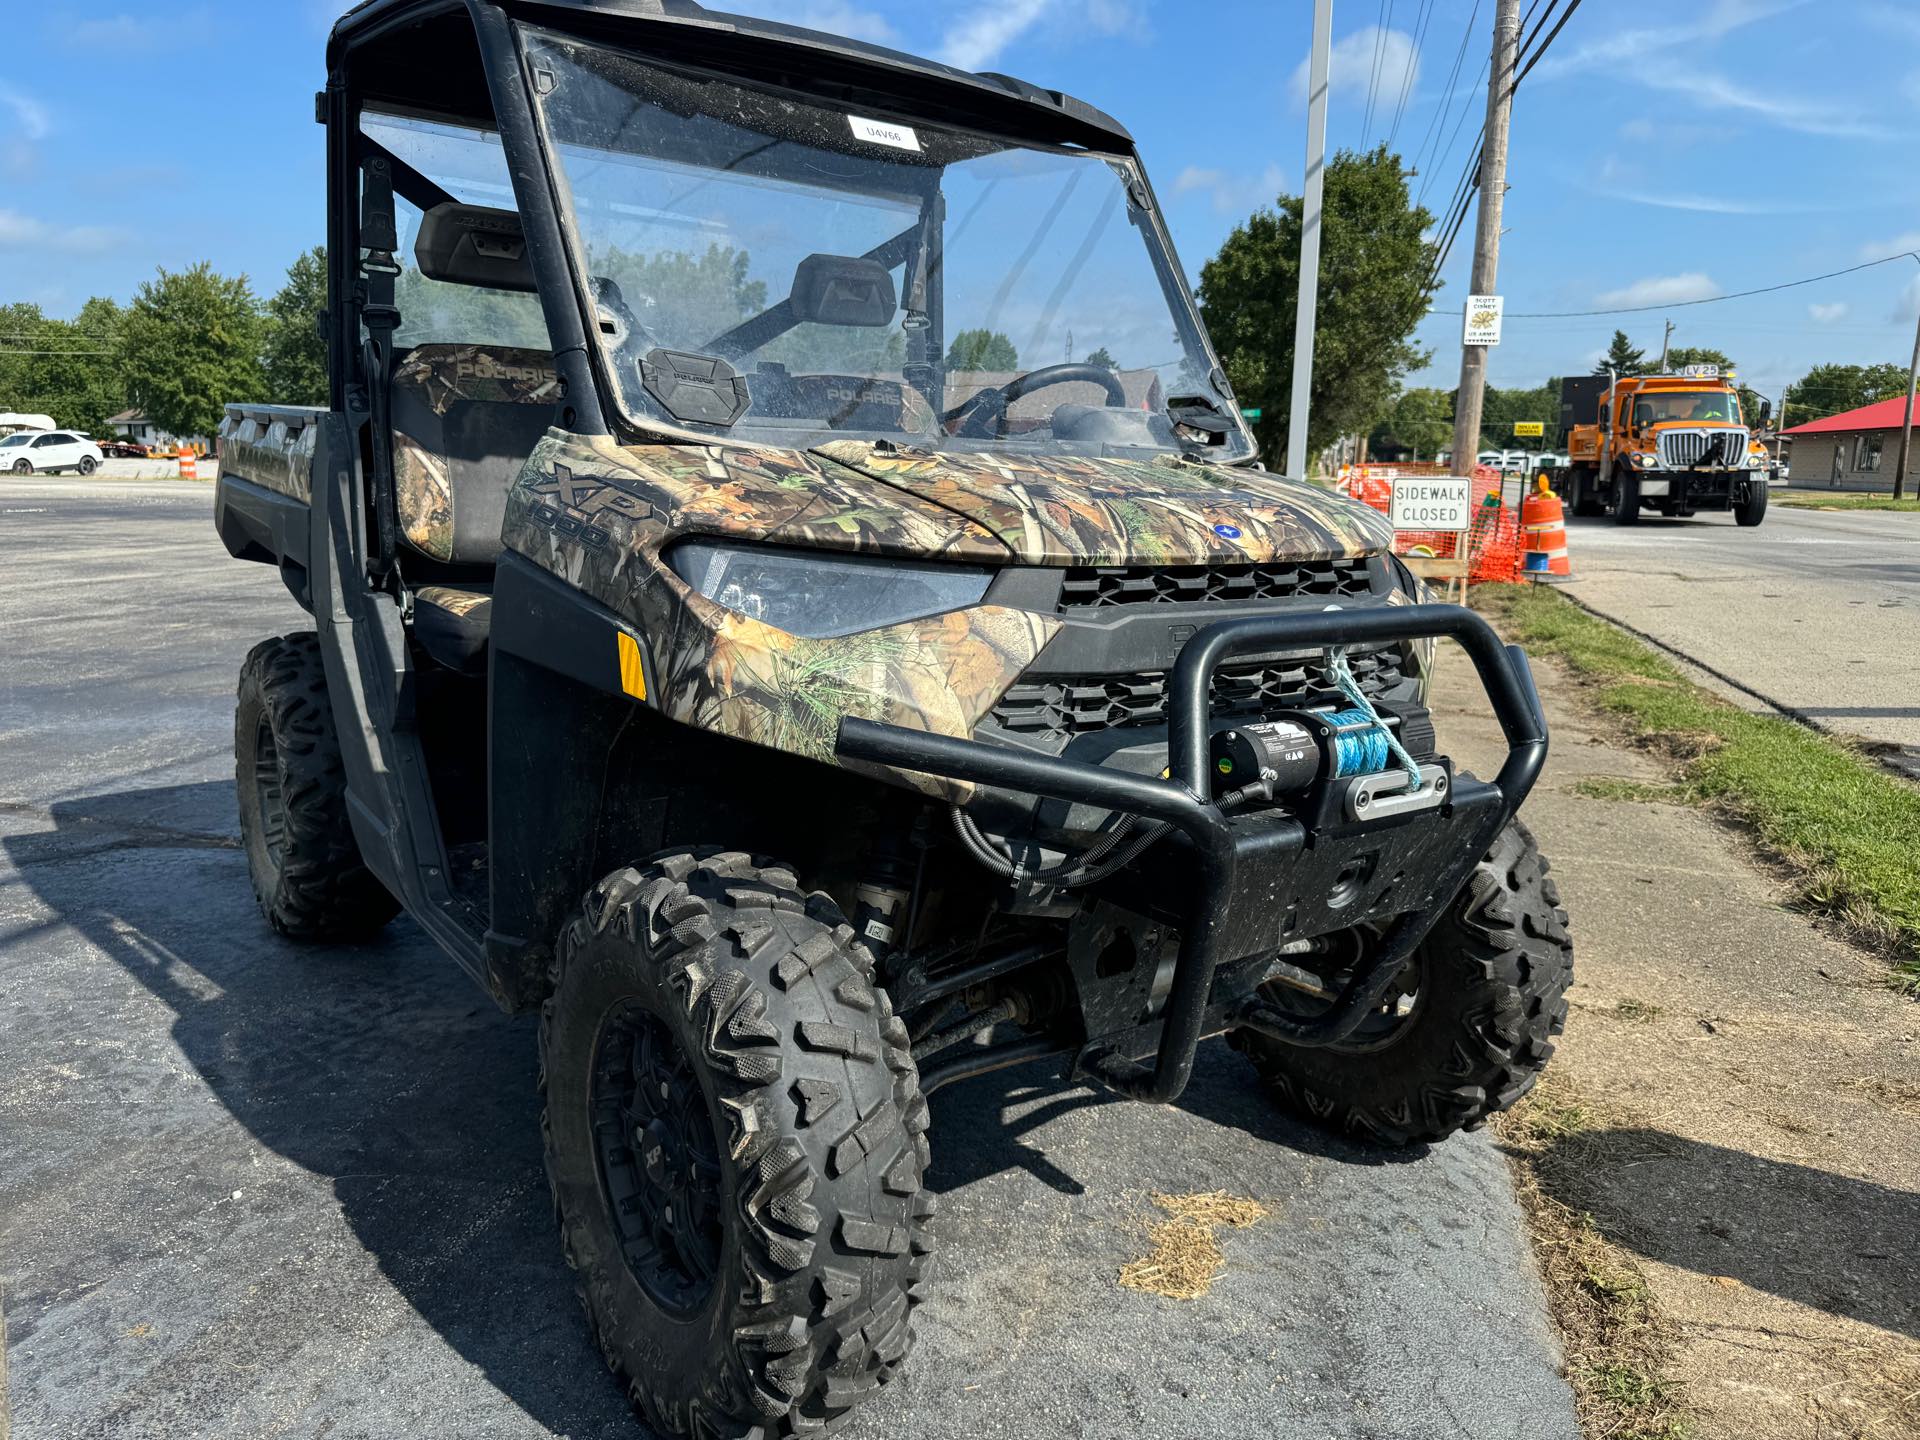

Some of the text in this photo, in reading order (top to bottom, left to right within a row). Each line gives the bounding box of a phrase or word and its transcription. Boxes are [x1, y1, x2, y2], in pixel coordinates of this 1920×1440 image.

[866, 127, 901, 141] U4V66
[457, 363, 557, 383] POLARIS
[1686, 366, 1717, 375] LV 25
[826, 388, 900, 406] POLARIS
[527, 461, 654, 521] XP
[1396, 487, 1465, 501] SIDEWALK
[1403, 507, 1458, 521] CLOSED
[645, 1144, 662, 1168] XP
